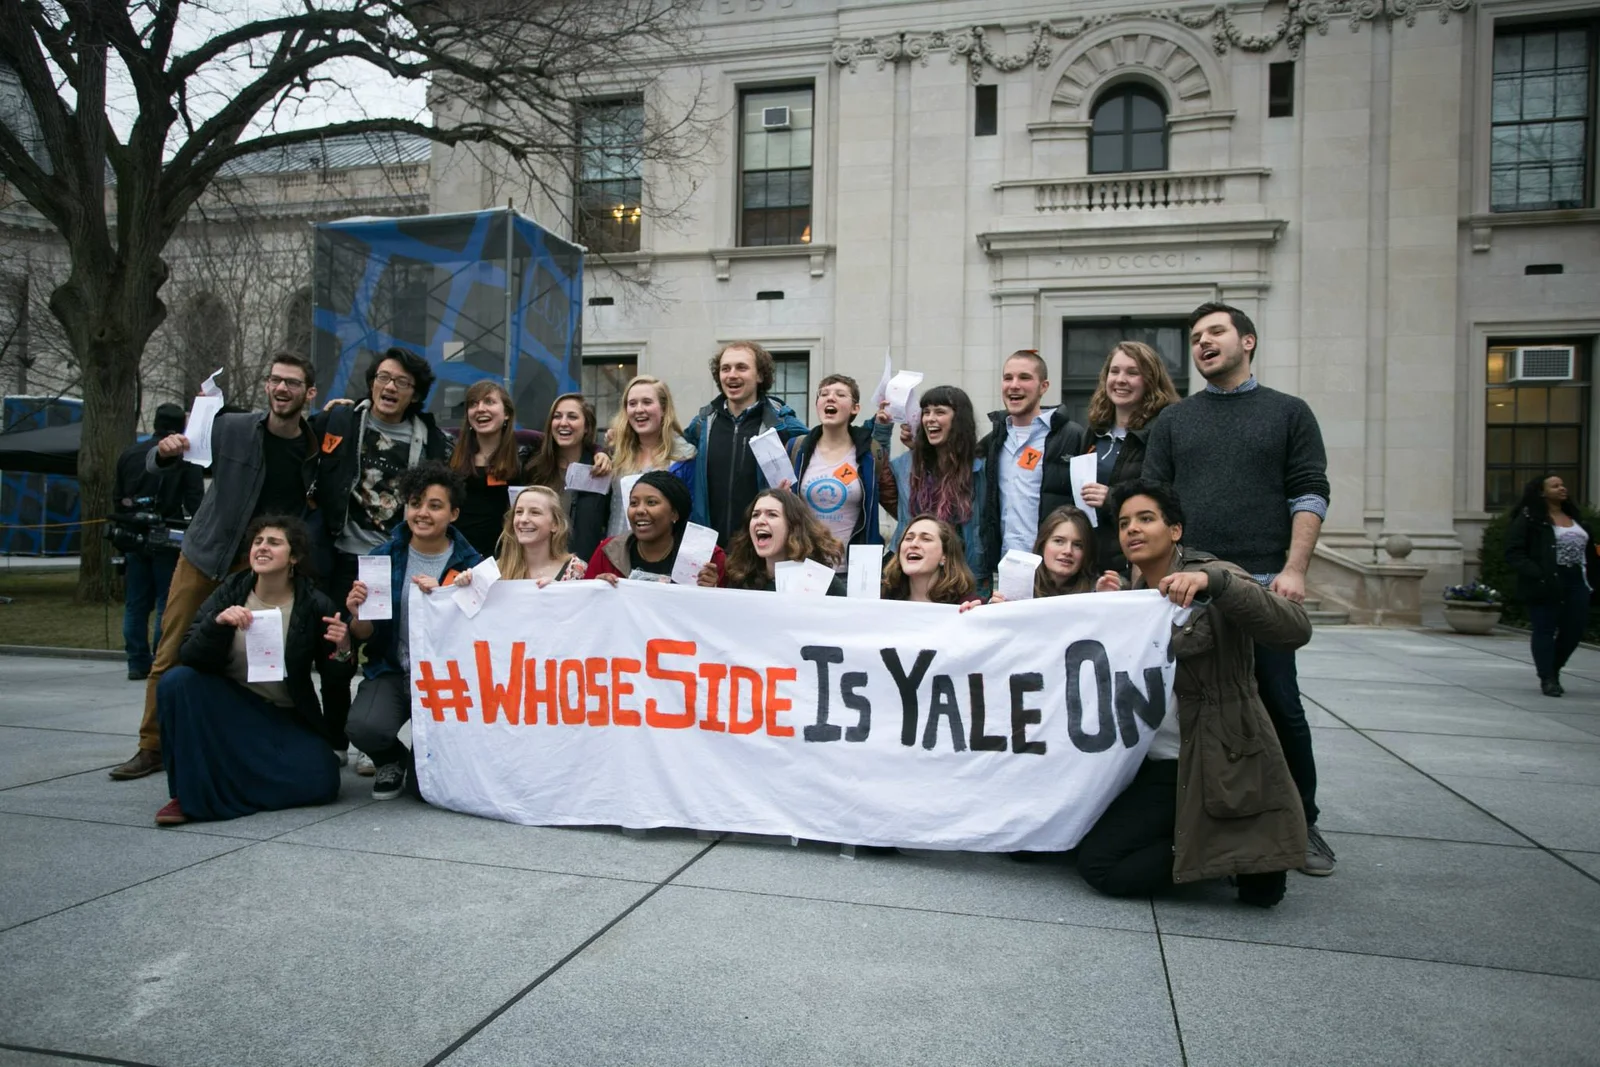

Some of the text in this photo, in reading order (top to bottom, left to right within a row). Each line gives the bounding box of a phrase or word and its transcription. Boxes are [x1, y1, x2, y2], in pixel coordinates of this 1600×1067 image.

[1025, 451, 1037, 466] Y
[879, 647, 1047, 754] YALE
[1064, 639, 1166, 754] ON
